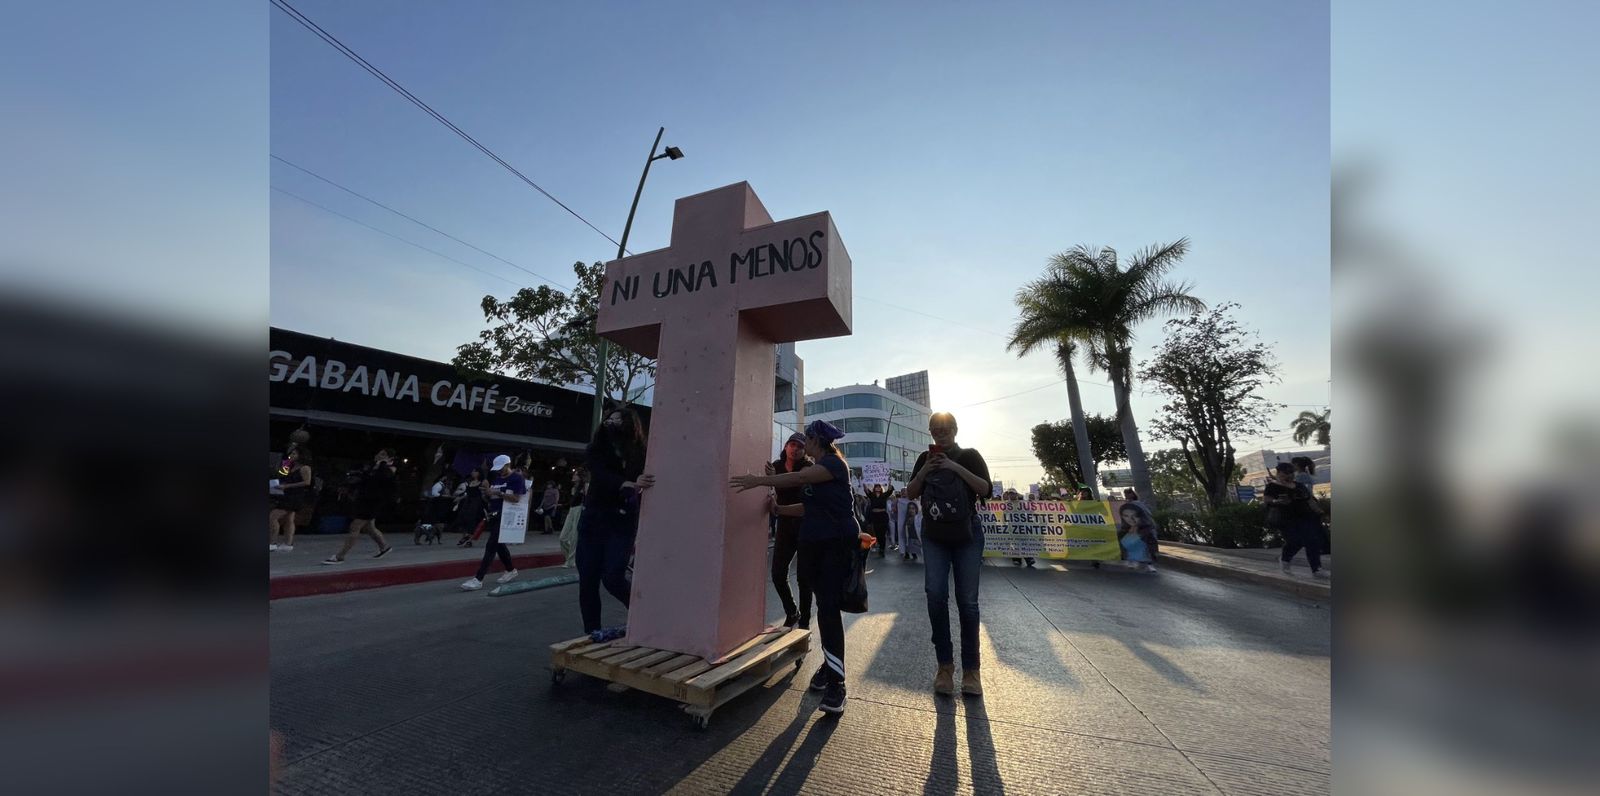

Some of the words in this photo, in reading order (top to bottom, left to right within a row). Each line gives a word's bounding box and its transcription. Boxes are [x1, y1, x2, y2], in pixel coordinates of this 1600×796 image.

[611, 275, 640, 306] NI
[652, 260, 718, 298] UNA
[730, 230, 825, 284] MENOS
[269, 350, 420, 404] GABANA
[430, 380, 500, 414] CAFÉ
[501, 396, 553, 417] Bistro
[976, 502, 1013, 512] IGIMOS
[1017, 502, 1067, 512] JUSTICIA
[1004, 513, 1054, 524] LISSETTE
[1058, 514, 1106, 525] PAULINA
[982, 525, 1009, 535] OMEZ
[1012, 525, 1064, 536] ZENTENO
